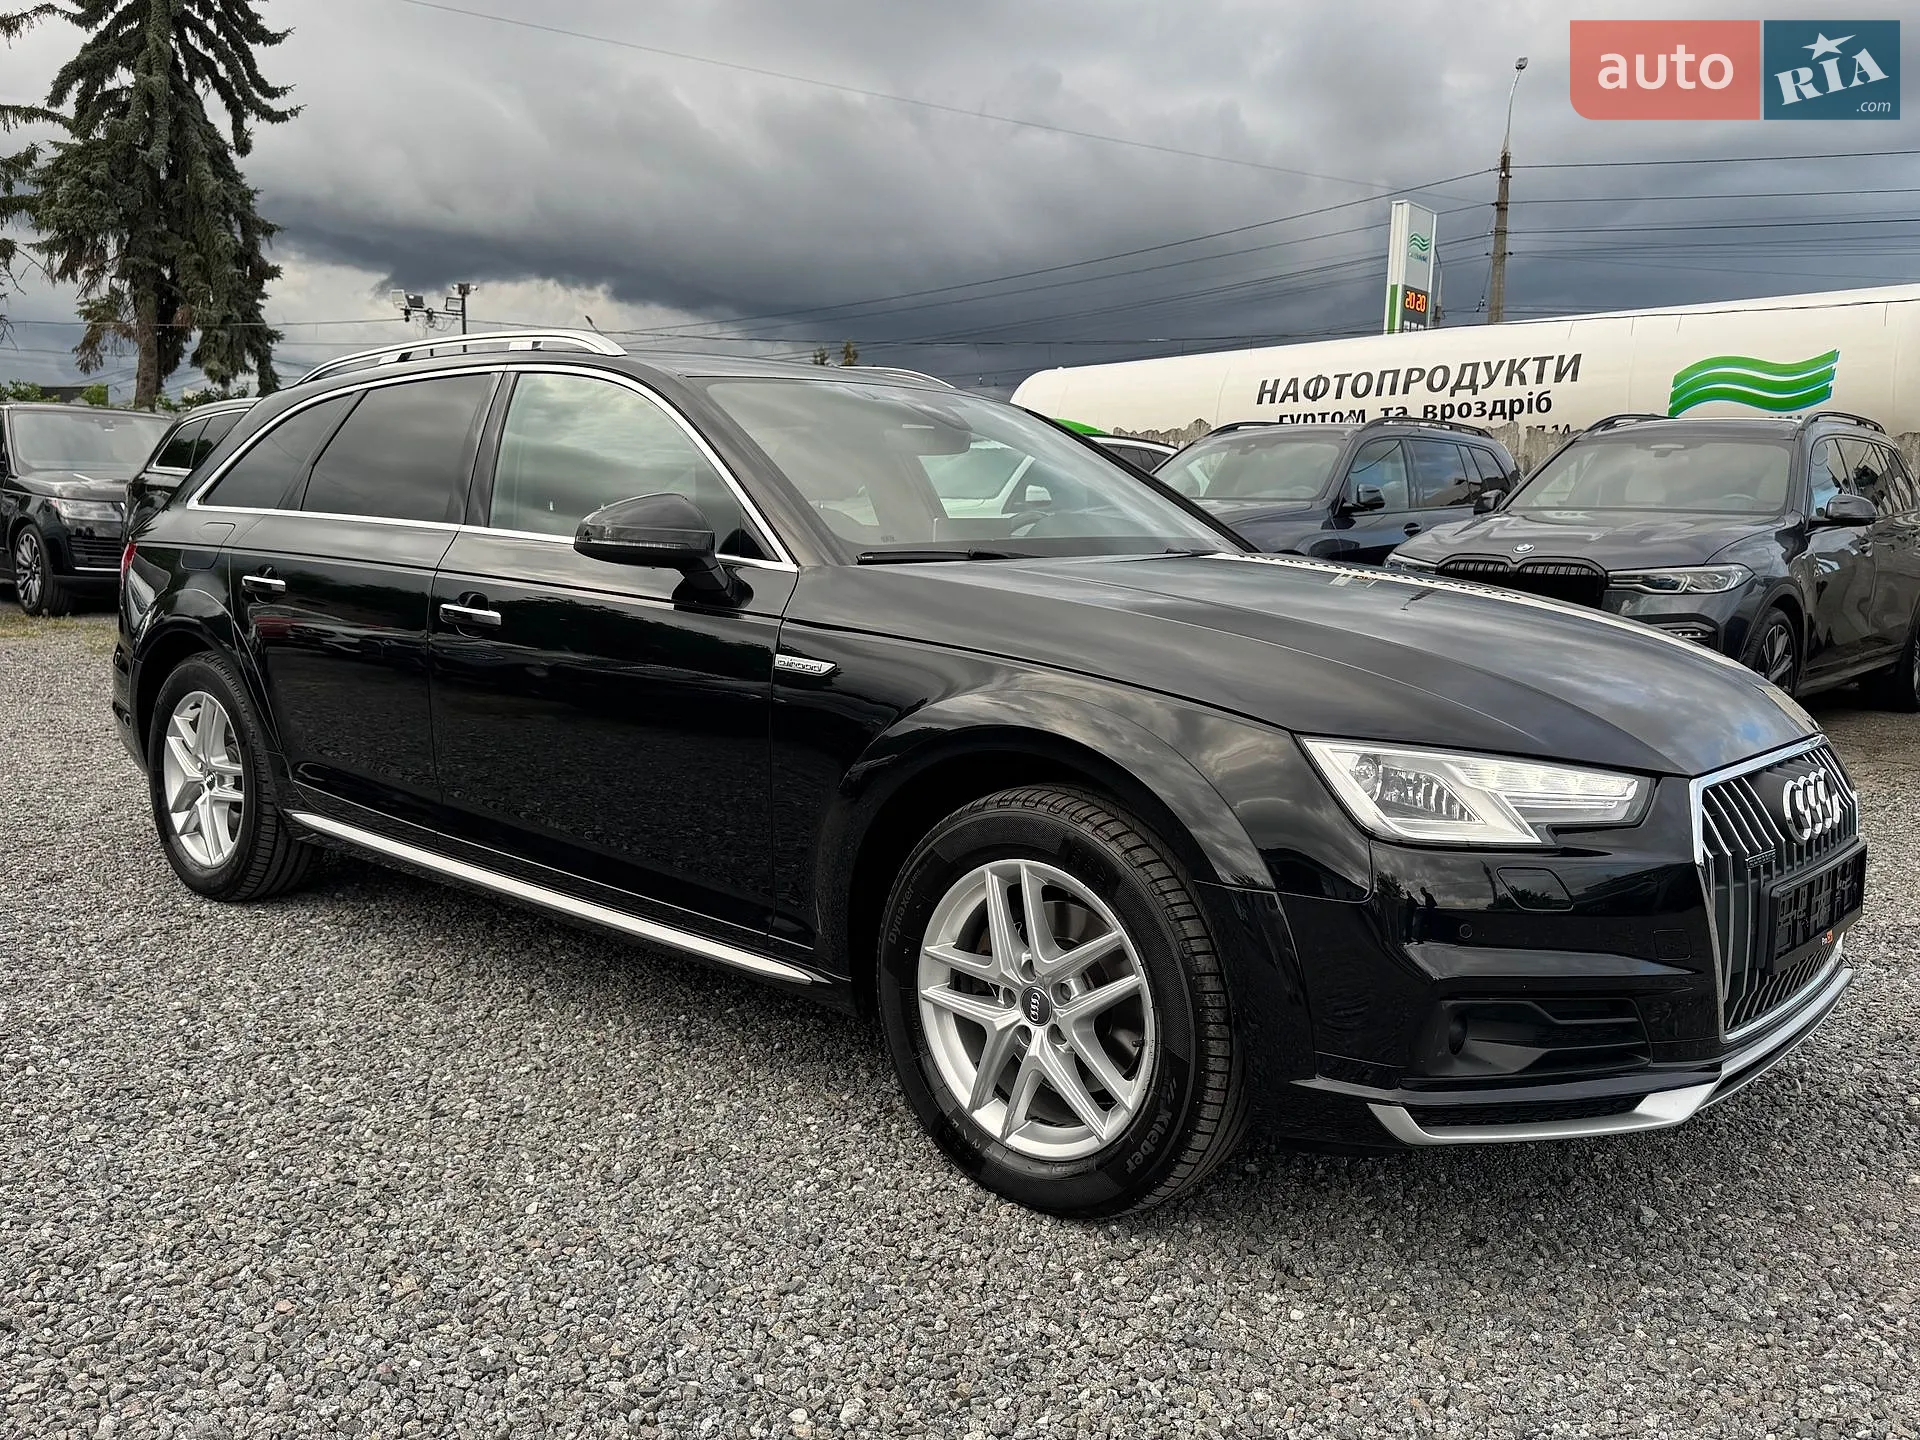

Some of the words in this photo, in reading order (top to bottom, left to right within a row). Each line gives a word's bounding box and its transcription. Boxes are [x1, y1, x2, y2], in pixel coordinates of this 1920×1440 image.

[1256, 353, 1583, 405] НАФТОПРОДУКТИ
[1422, 390, 1553, 422] вроздріб
[1126, 1107, 1173, 1175] Kleber
